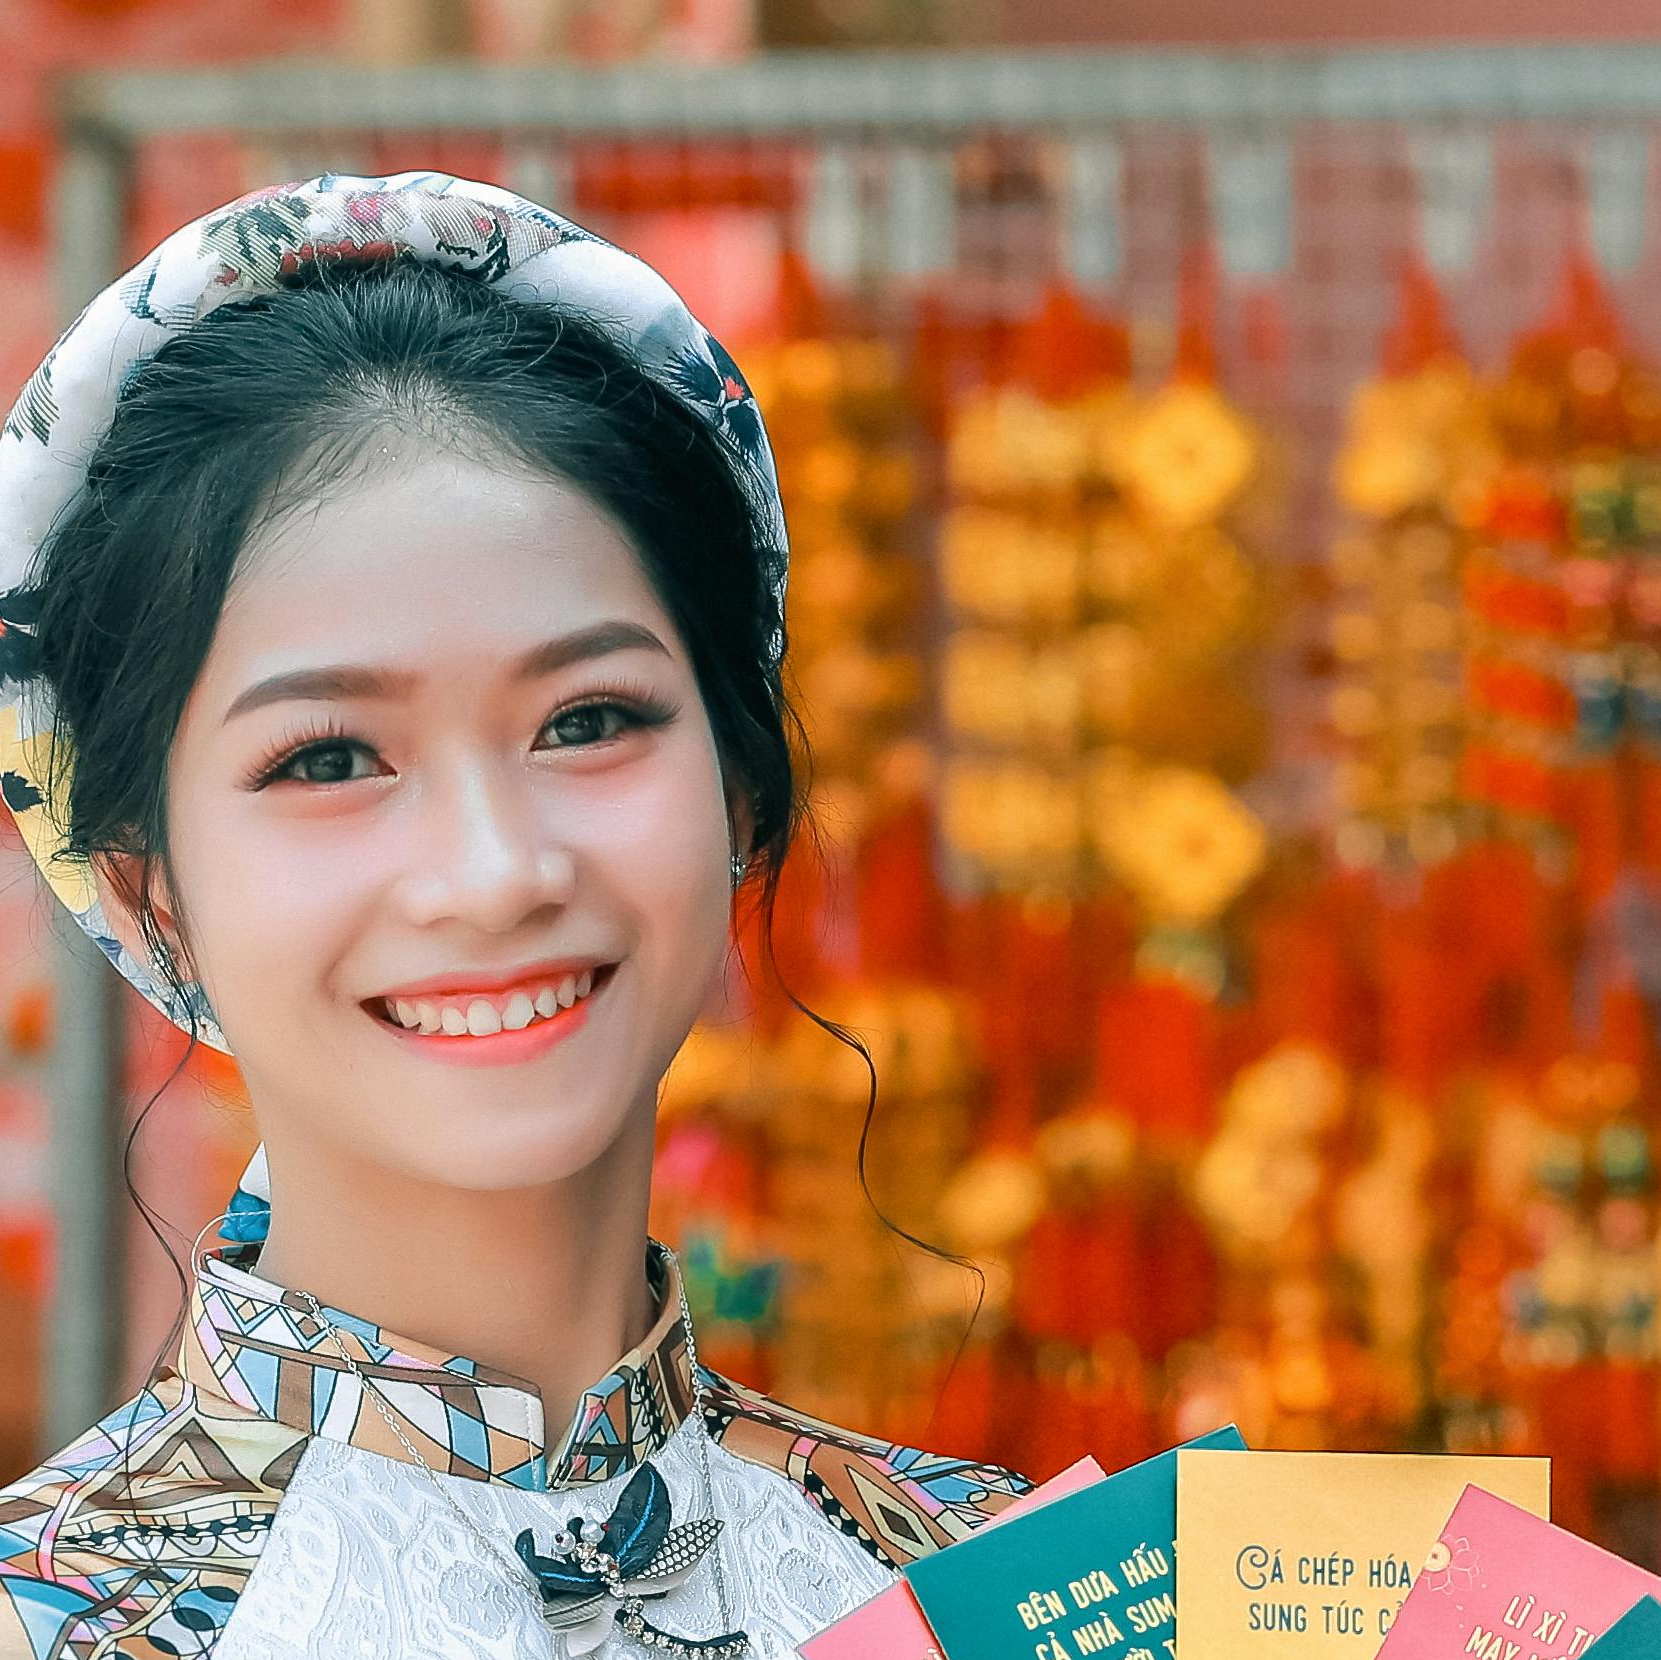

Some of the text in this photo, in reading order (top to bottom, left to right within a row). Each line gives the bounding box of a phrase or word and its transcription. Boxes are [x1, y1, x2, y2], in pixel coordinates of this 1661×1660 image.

[1017, 1590, 1067, 1630] BÊN
[1068, 1570, 1119, 1609] DƯA
[1119, 1541, 1169, 1588] HẤU
[1236, 1545, 1412, 1590] CÁ CHÉP HÓA
[1072, 1611, 1124, 1656] NHÀ
[1126, 1592, 1177, 1634] SUM
[1249, 1599, 1403, 1636] SUNG TÚC C
[1503, 1595, 1536, 1629] LÌ
[1532, 1611, 1567, 1645] XÌ
